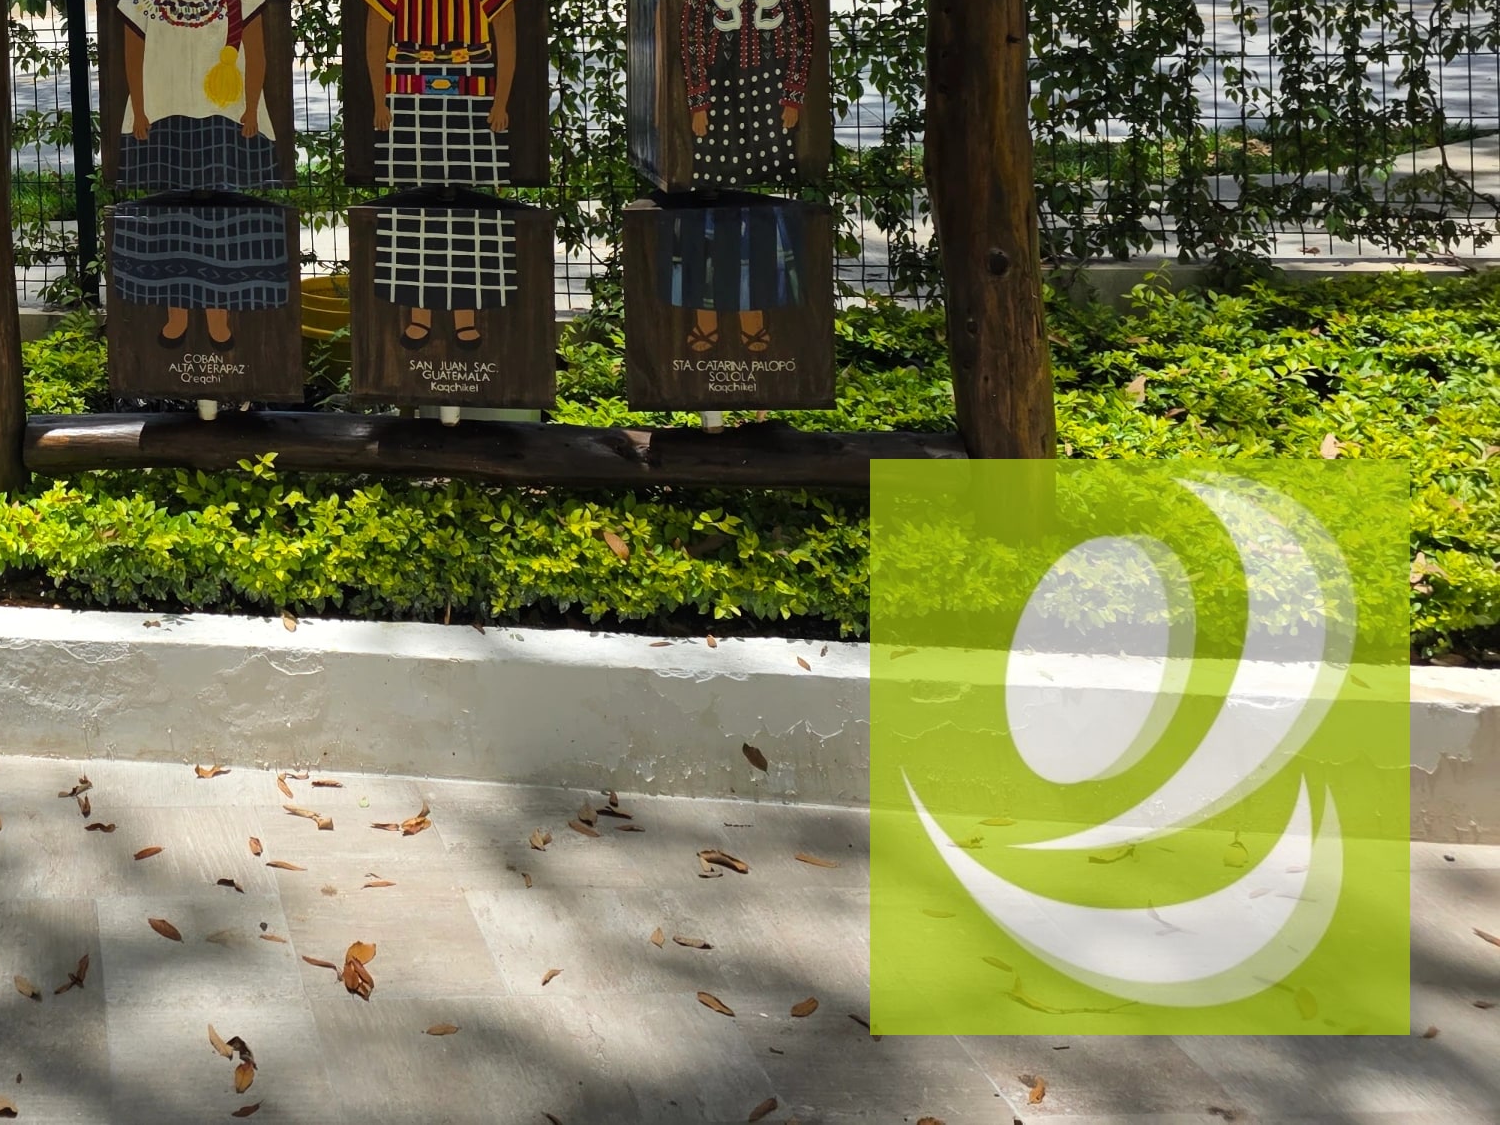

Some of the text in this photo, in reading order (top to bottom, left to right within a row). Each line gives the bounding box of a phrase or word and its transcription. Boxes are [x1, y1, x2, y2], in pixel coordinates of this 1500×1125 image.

[183, 352, 224, 364] COBÁN
[168, 363, 245, 374] ALTA VERAPAZ
[409, 359, 499, 374] SAN JUAN SAC.
[422, 370, 491, 382] GUATEMALA
